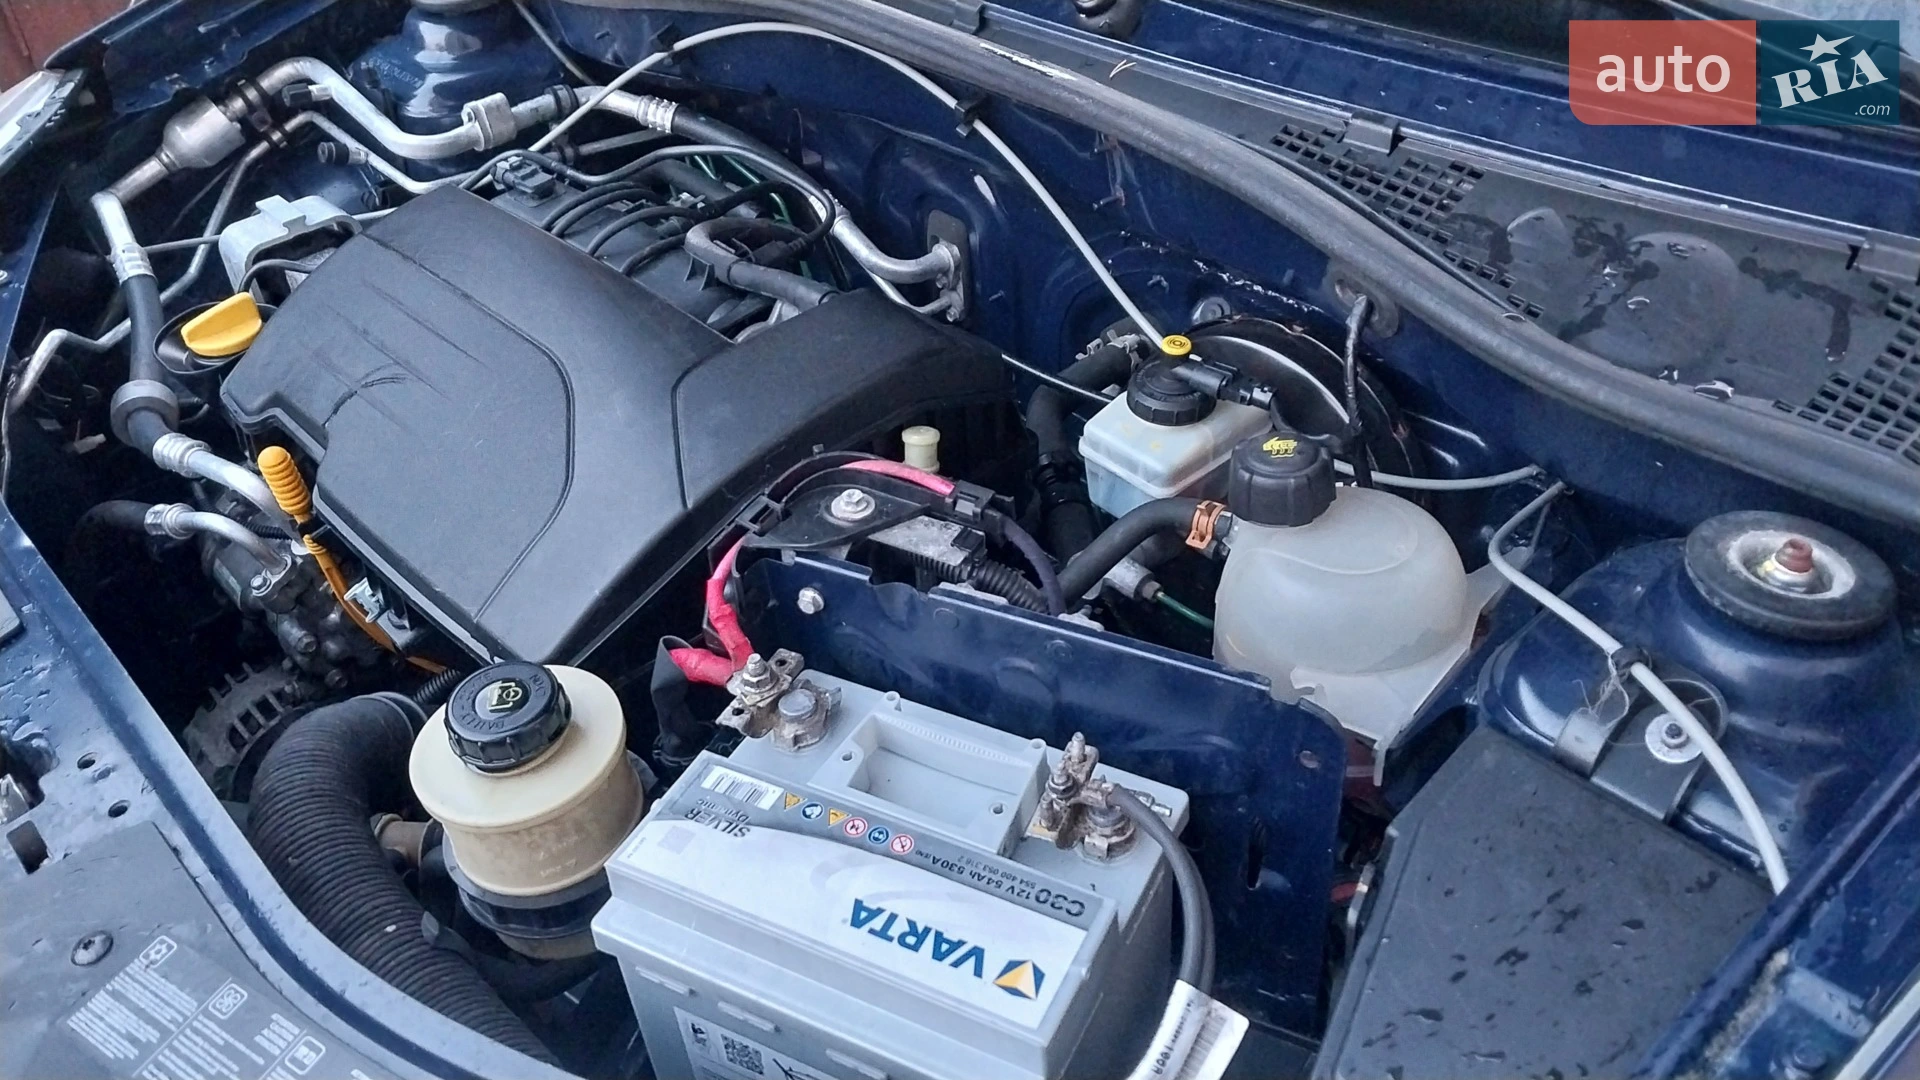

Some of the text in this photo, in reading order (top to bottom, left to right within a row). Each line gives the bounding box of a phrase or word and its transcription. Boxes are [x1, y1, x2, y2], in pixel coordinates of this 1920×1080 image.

[684, 808, 751, 838] SILVER
[1005, 885, 1031, 900] 12V
[1034, 888, 1086, 917] C30
[850, 898, 985, 979] VARTA
